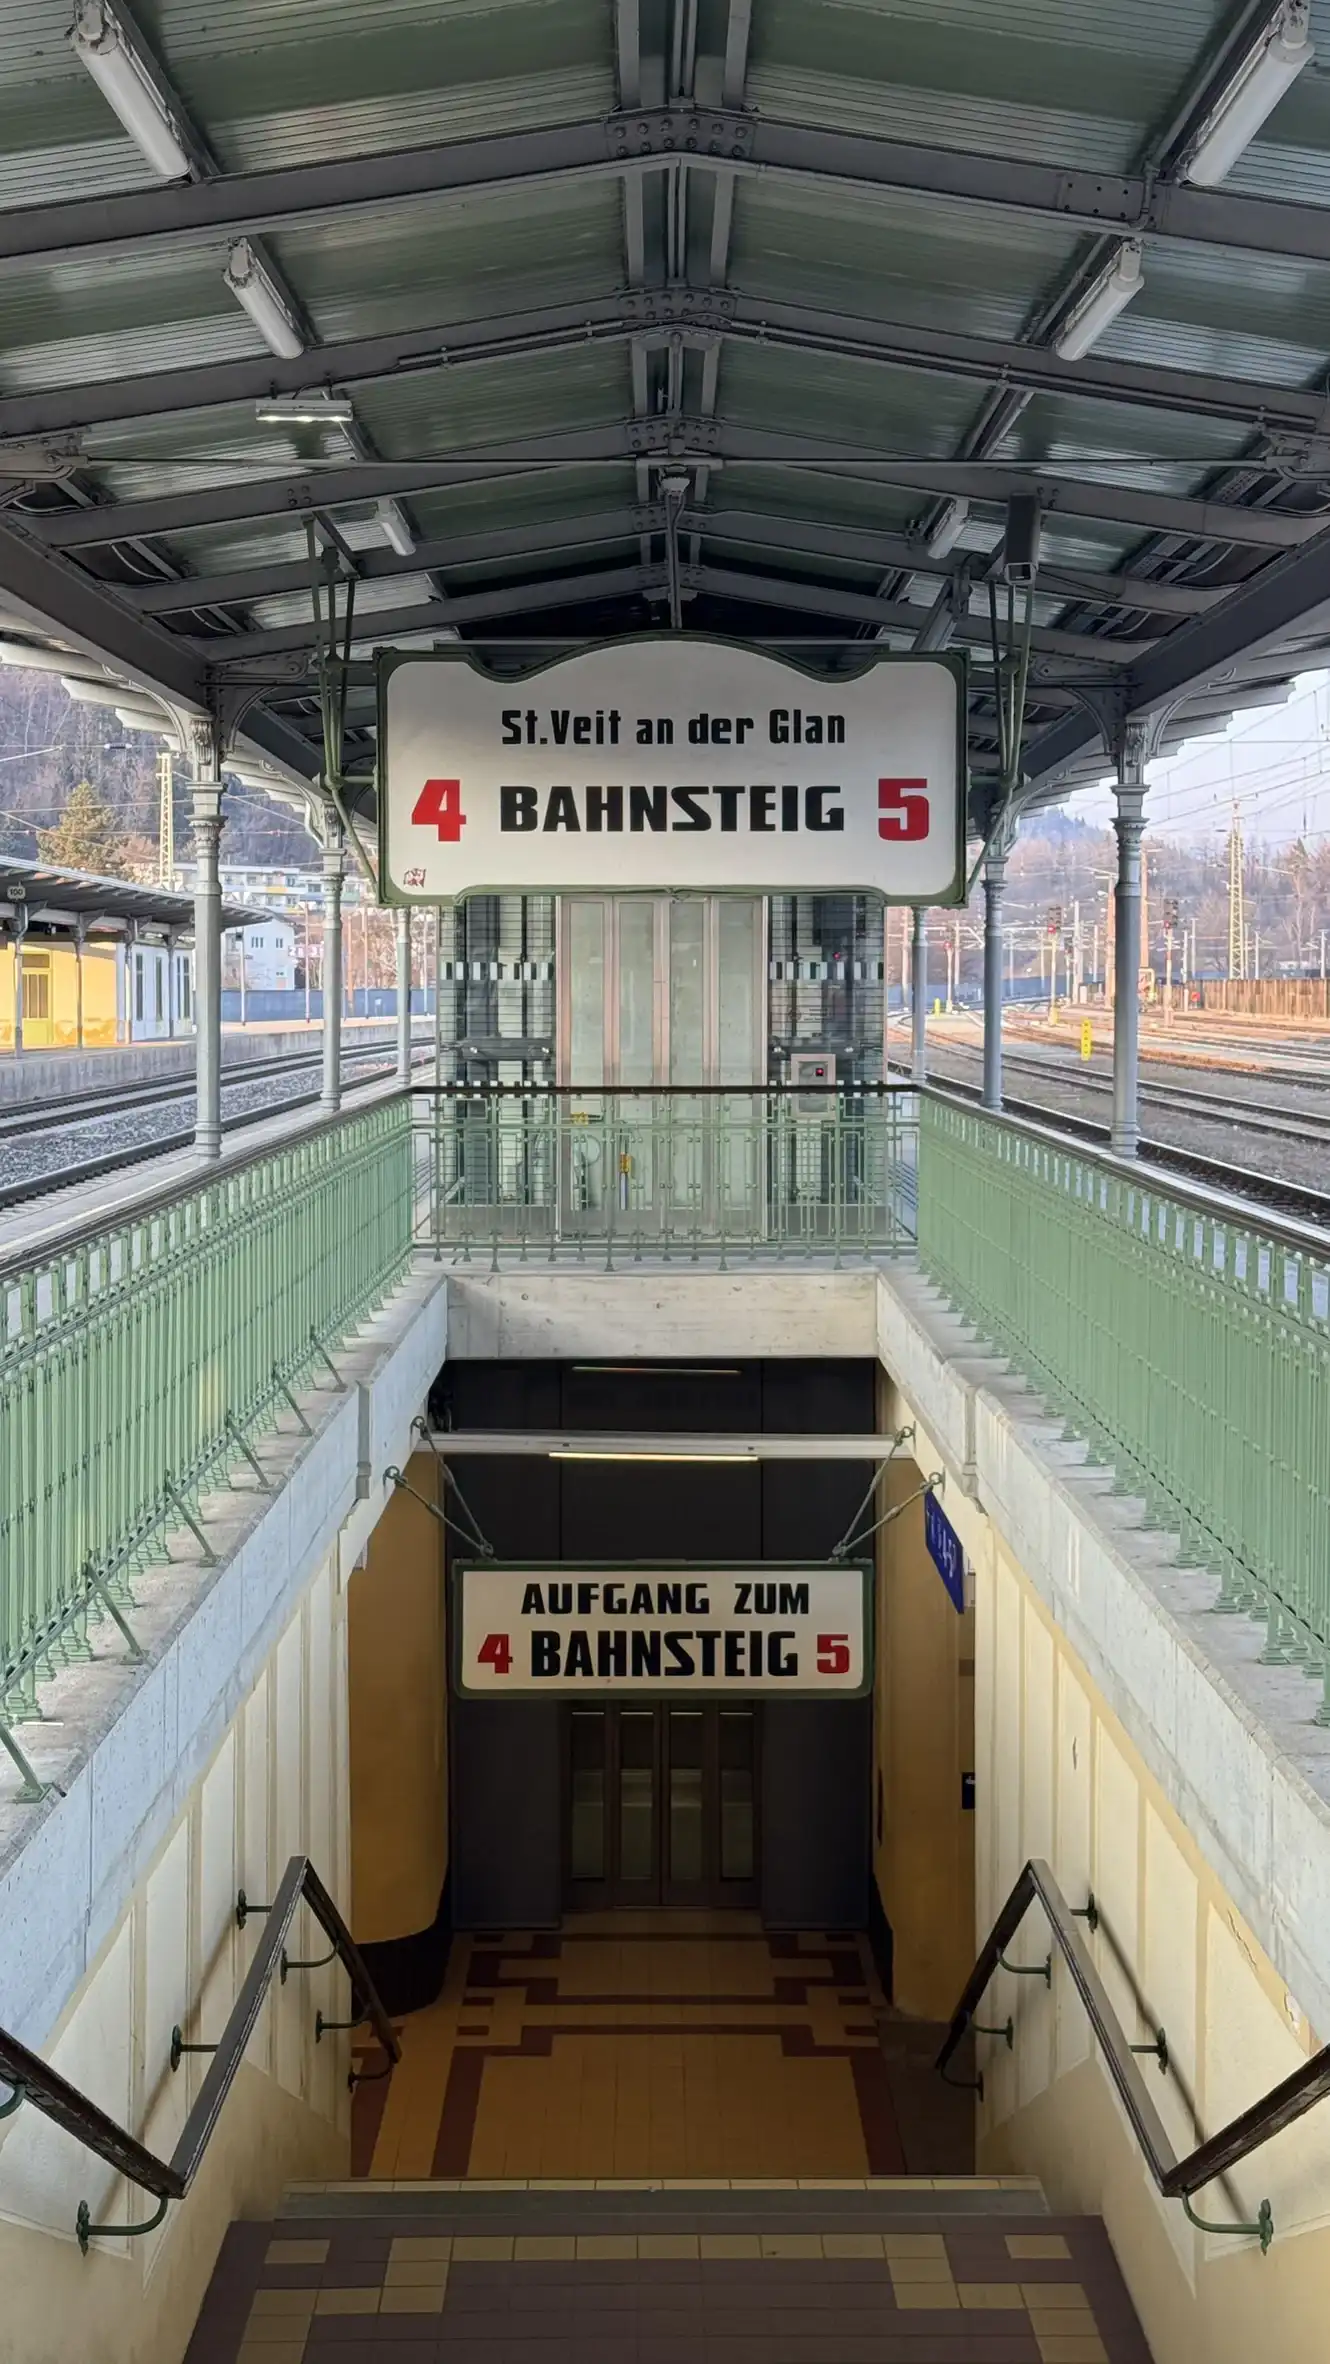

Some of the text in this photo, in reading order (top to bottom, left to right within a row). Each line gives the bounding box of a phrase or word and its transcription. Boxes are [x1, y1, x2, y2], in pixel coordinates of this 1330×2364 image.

[636, 719, 673, 744] an
[688, 713, 754, 744] der
[770, 709, 845, 744] Glan
[411, 779, 929, 842] 4 BAHNSTEIG 5
[521, 1583, 809, 1614] AUFGANG ZUM
[477, 1631, 850, 1676] 4 BAHNSTEIG 5
